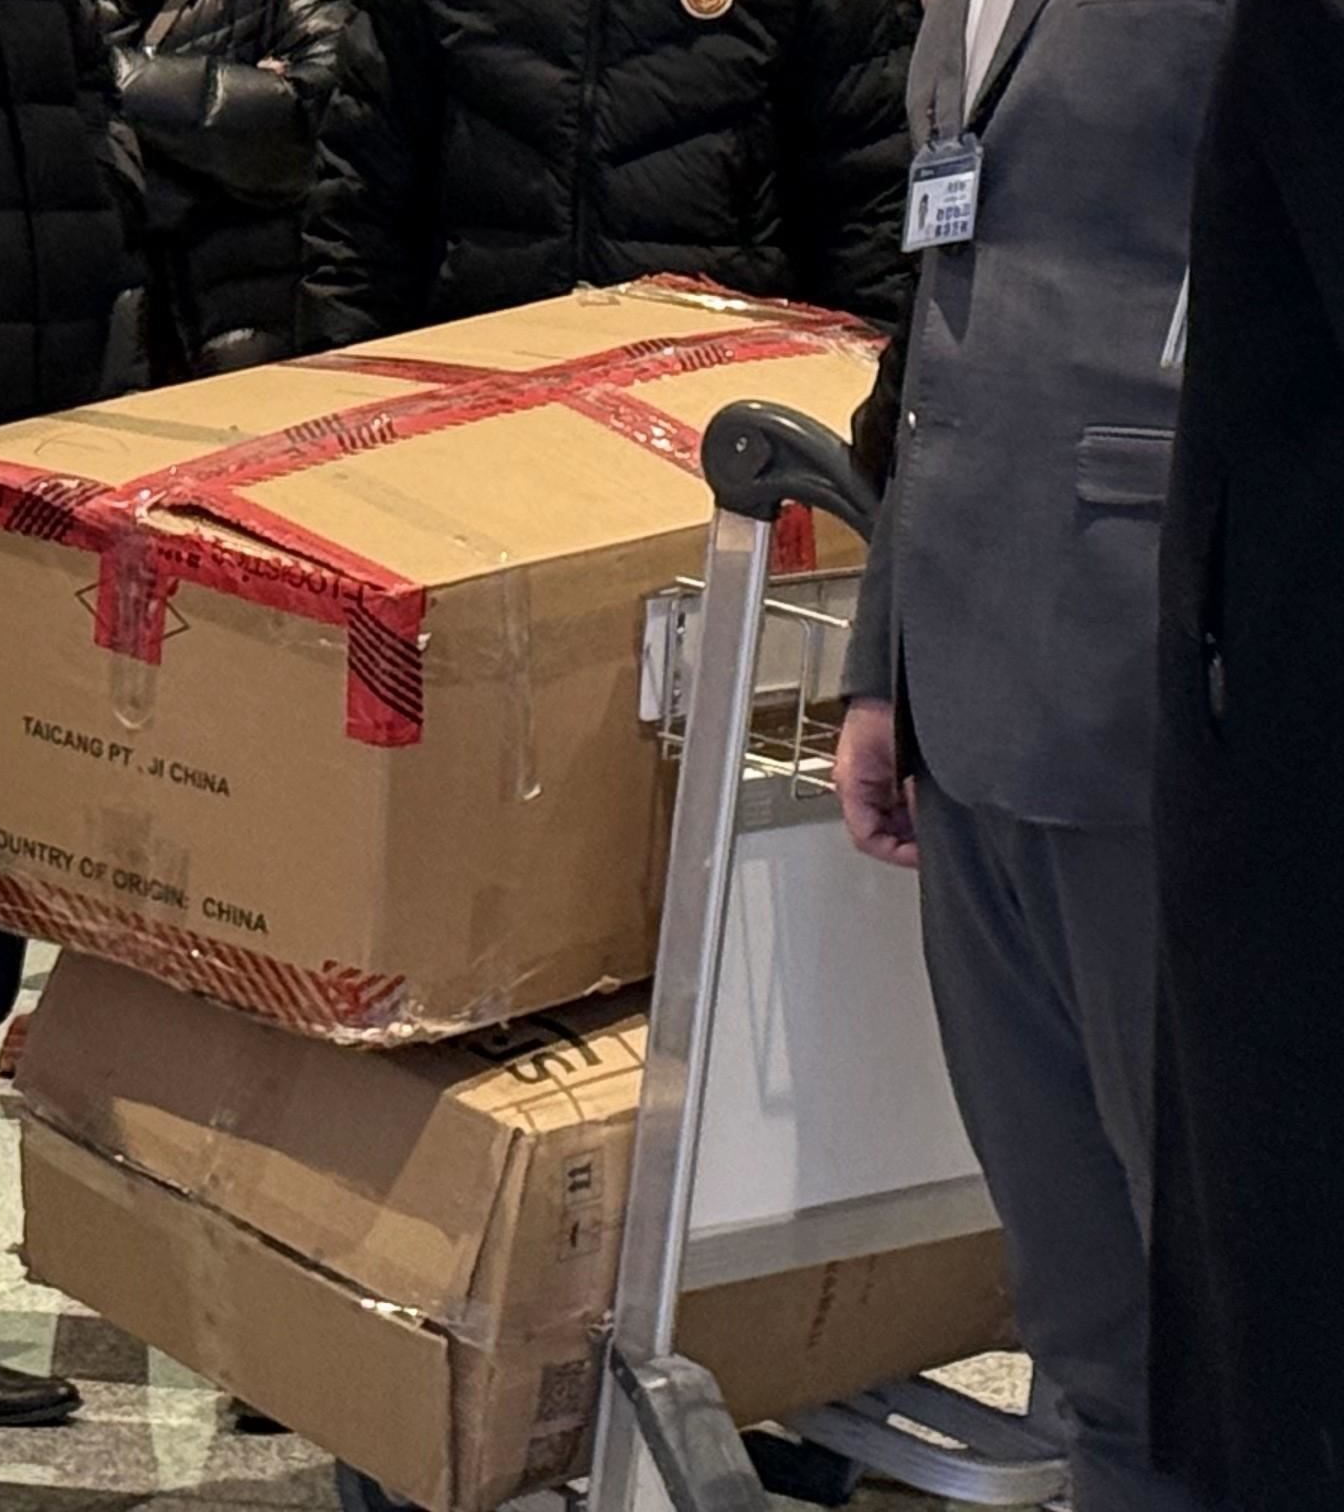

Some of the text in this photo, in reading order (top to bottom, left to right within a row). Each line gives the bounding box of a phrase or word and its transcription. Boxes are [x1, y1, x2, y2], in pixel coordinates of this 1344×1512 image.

[22, 715, 105, 759] TAICANG
[107, 742, 135, 767] PT
[168, 762, 231, 798] CHINA
[79, 856, 109, 881] OF
[201, 896, 270, 935] CHINA
